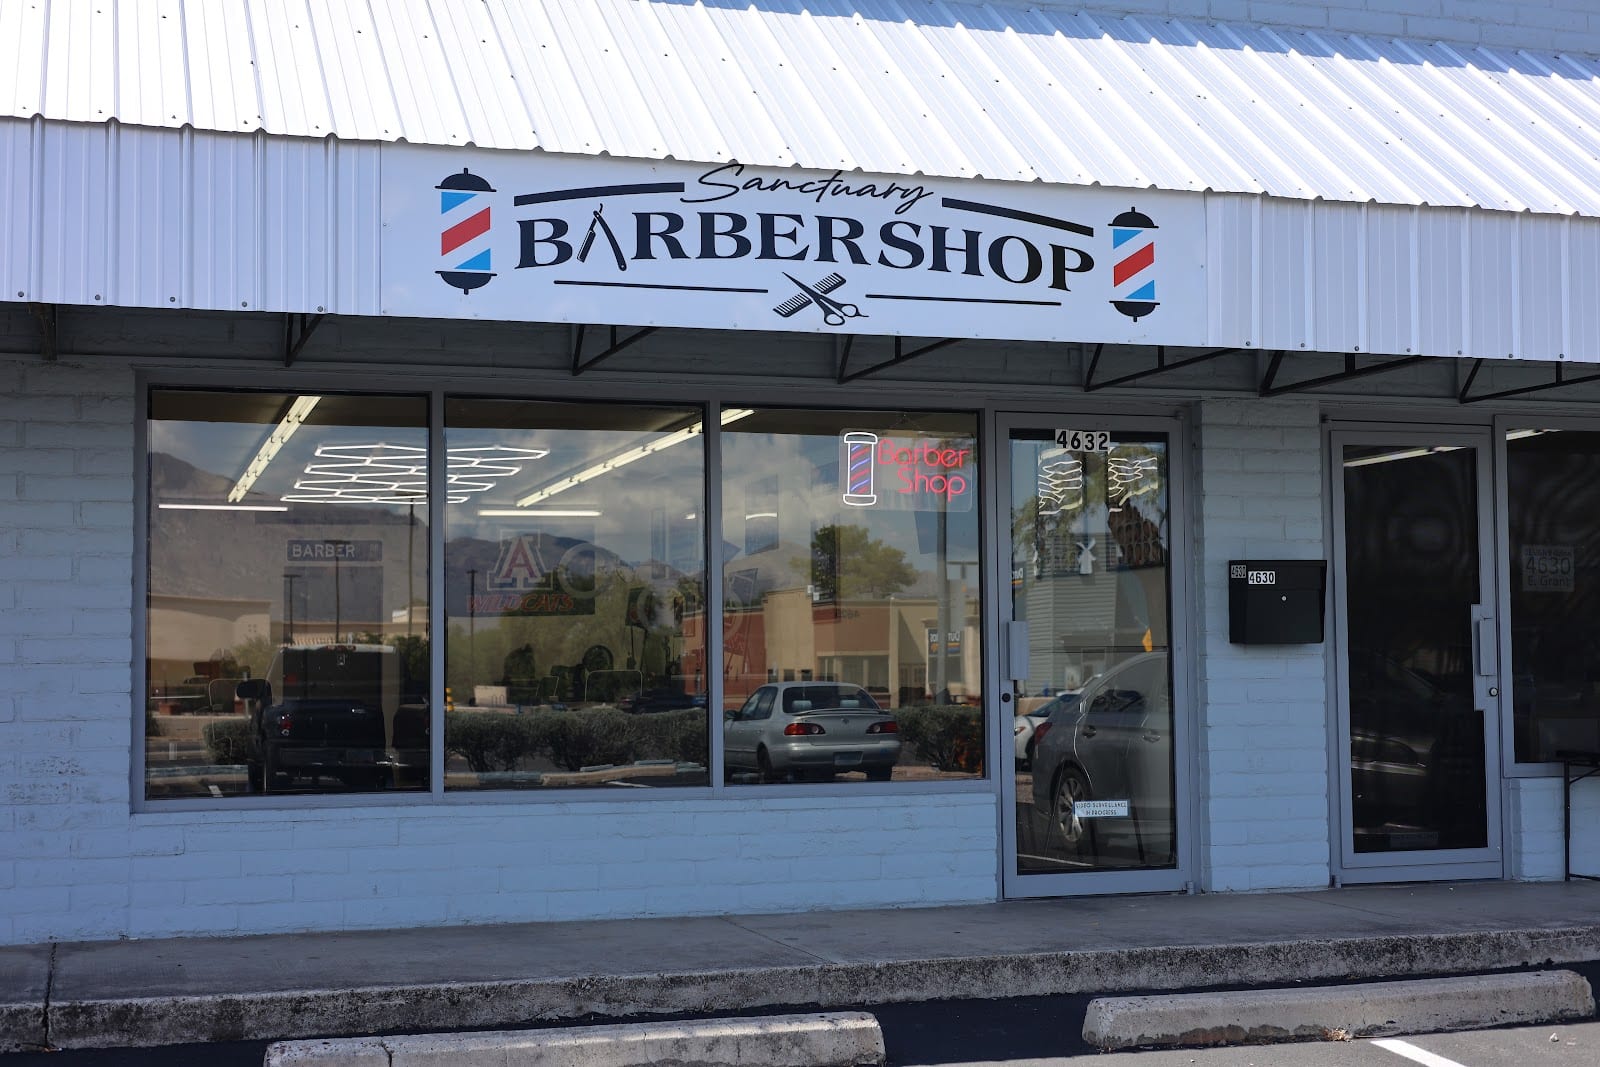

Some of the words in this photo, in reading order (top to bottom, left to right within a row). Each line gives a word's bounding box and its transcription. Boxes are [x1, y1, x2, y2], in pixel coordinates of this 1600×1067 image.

[679, 163, 934, 215] Sanctuary
[513, 203, 1095, 292] BARBERSHOP
[1056, 430, 1109, 451] 4632
[877, 438, 970, 469] Barber
[896, 467, 967, 503] Shop
[292, 543, 355, 558] BARBER
[1526, 556, 1571, 575] 4630
[1250, 572, 1275, 584] 4630
[1540, 575, 1569, 587] Grant
[466, 593, 575, 613] WILDCATS
